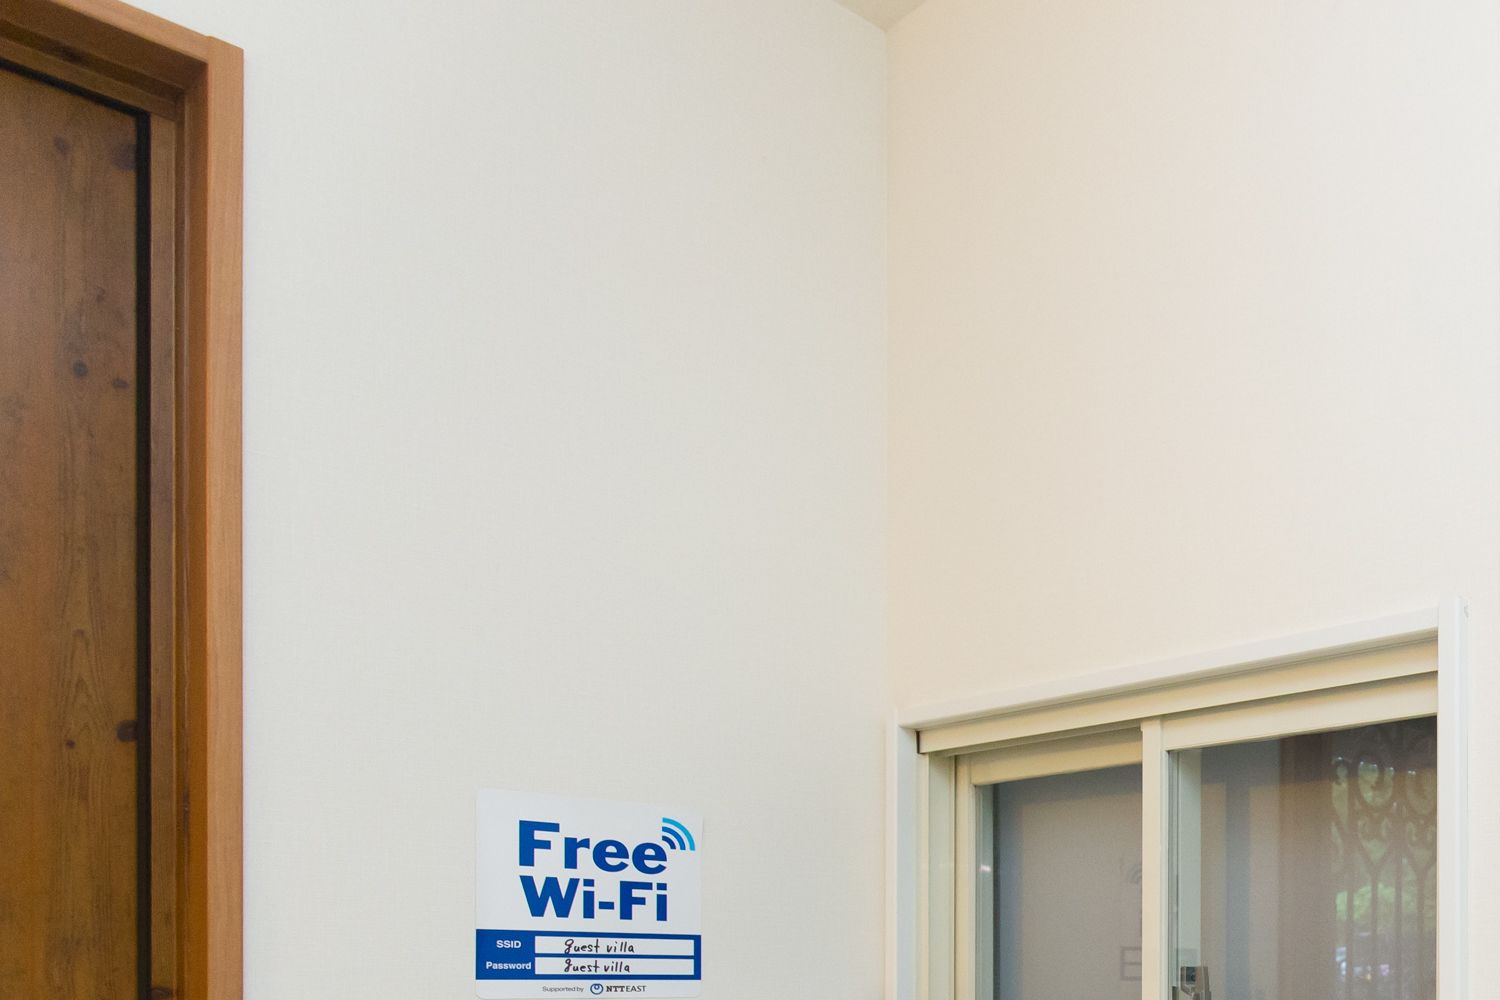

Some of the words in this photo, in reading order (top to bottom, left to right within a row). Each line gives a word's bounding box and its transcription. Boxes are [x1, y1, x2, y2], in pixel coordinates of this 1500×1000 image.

[518, 819, 668, 875] Free
[518, 875, 668, 922] Wi-Fi
[496, 939, 522, 949] SSID
[564, 938, 600, 954] guest
[606, 941, 635, 954] villa
[485, 961, 532, 970] Password
[564, 959, 600, 973] guest
[604, 961, 630, 973] villa
[542, 985, 576, 993] Supported
[576, 985, 584, 993] by
